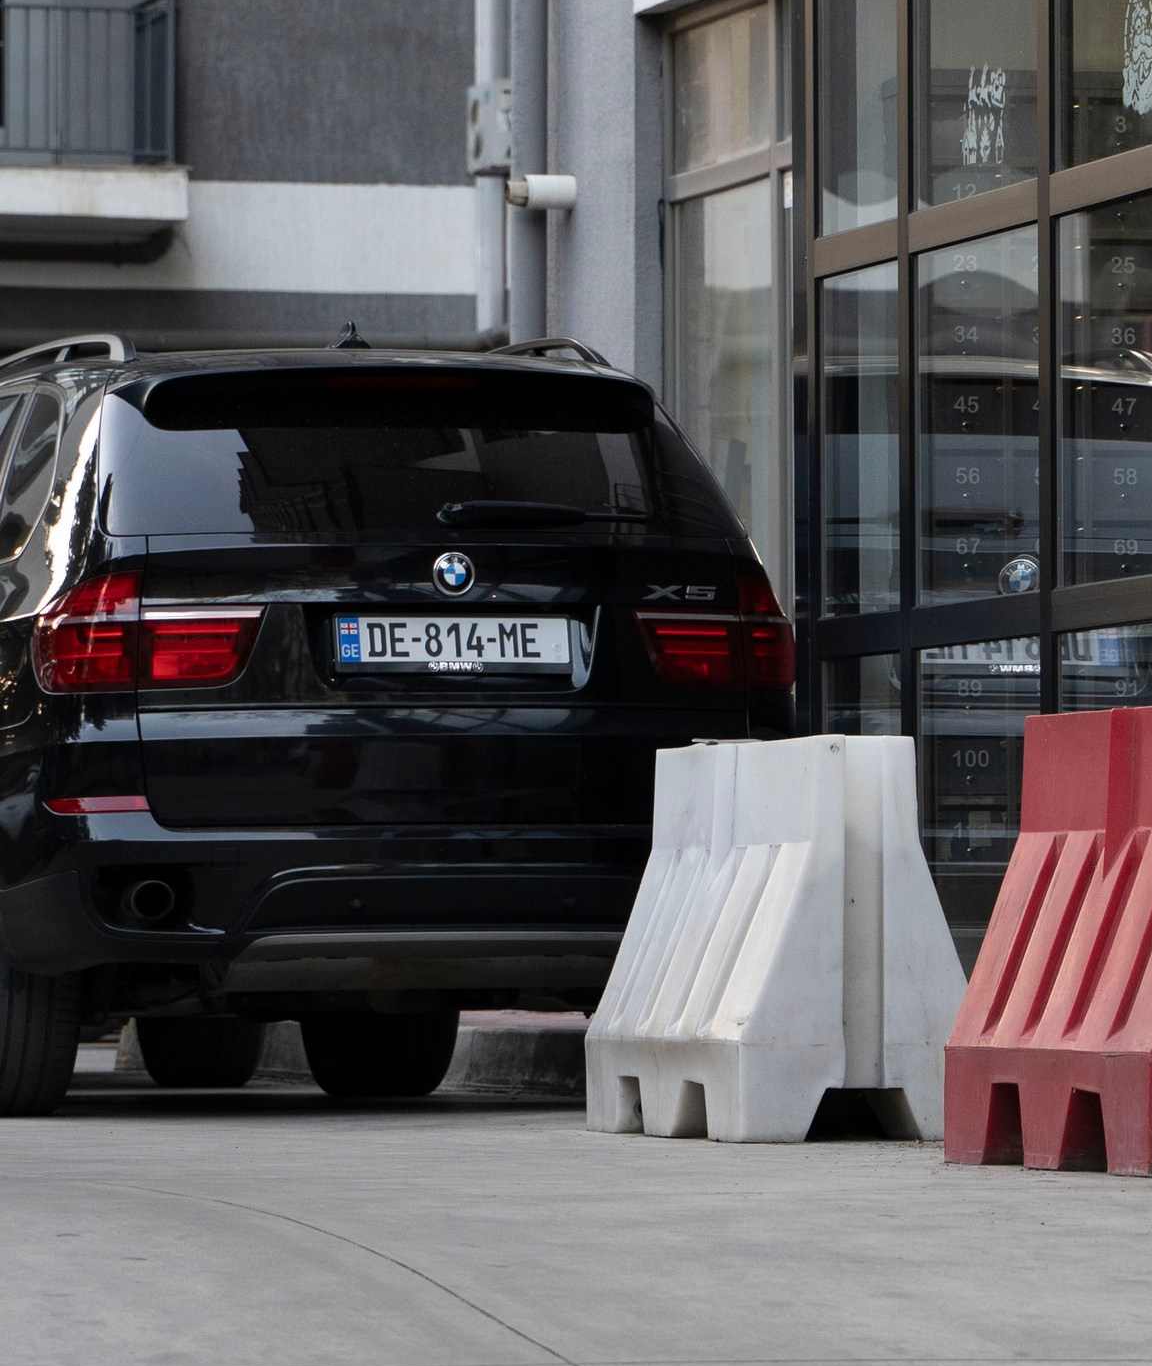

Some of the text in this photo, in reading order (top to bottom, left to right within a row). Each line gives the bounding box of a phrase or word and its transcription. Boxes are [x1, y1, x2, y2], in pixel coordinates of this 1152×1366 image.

[1114, 116, 1126, 133] 3
[952, 253, 978, 271] 23
[1111, 256, 1136, 274] 25
[954, 326, 979, 343] 34
[1111, 327, 1136, 345] 36
[953, 396, 979, 413] 45
[1111, 398, 1137, 415] 47
[955, 467, 980, 485] 56
[1113, 468, 1138, 486] 58
[955, 538, 981, 555] 67
[1113, 539, 1139, 556] 69
[641, 584, 717, 600] X5
[341, 622, 541, 658] GE DE-814-ME
[439, 661, 473, 671] BMW
[957, 680, 982, 697] 89
[1115, 679, 1138, 696] 91
[952, 750, 990, 767] 100
